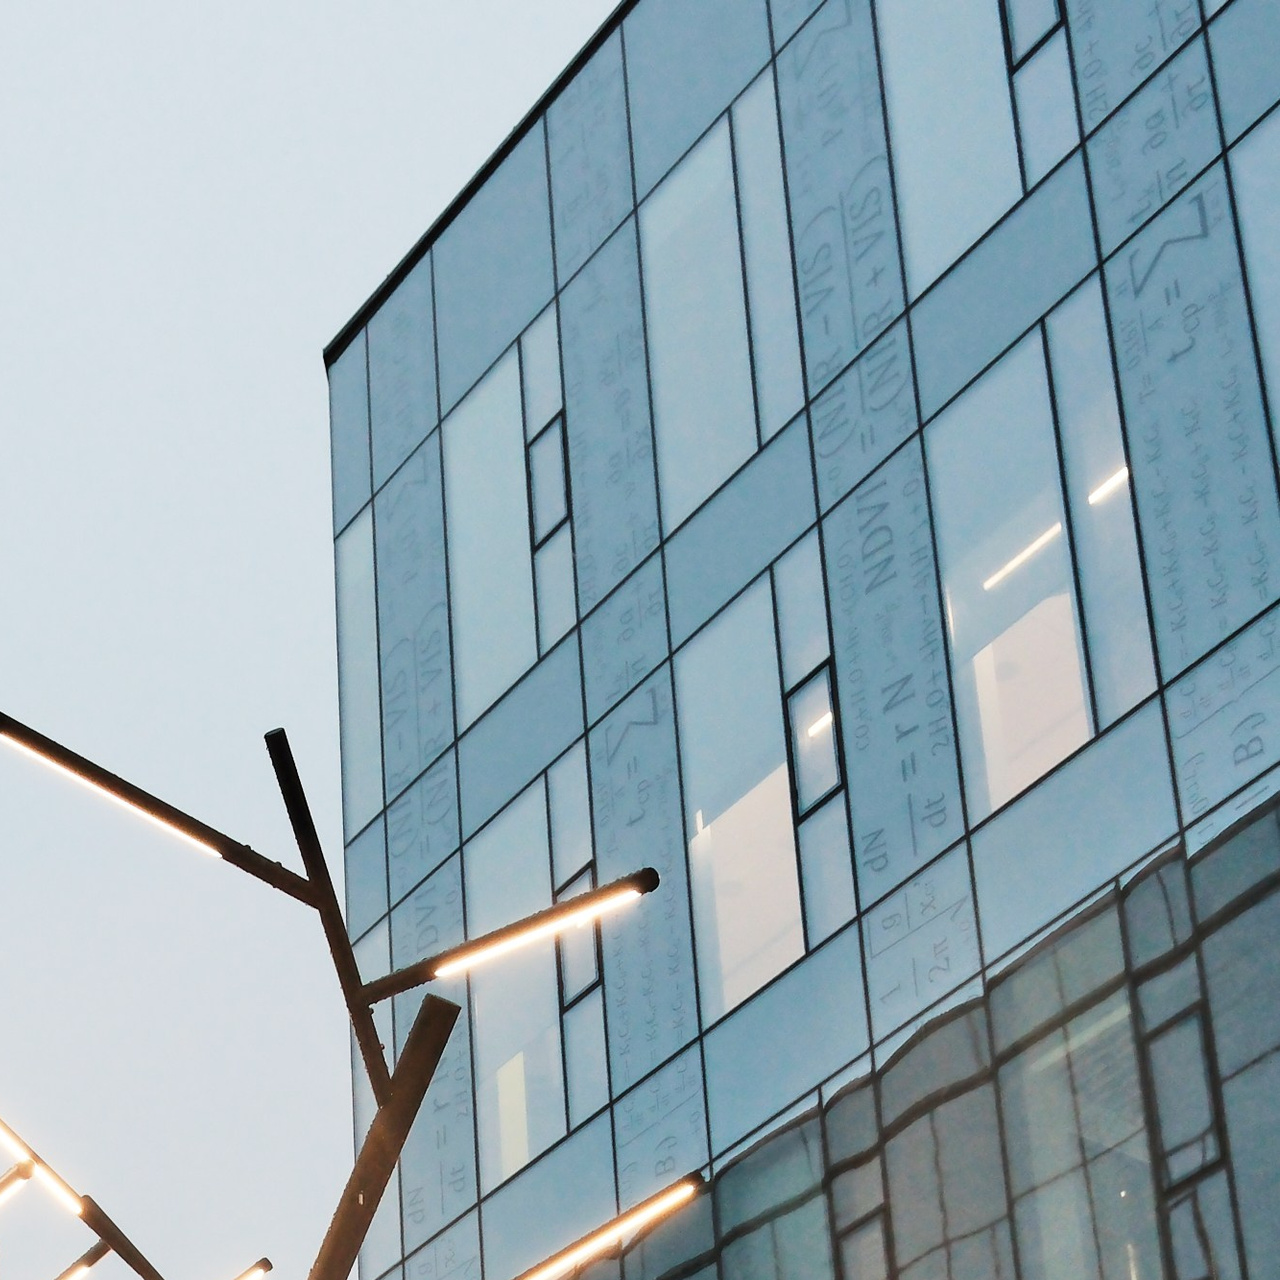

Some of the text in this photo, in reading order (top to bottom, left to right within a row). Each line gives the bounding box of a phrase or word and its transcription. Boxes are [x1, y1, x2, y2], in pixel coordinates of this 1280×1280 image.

[855, 480, 897, 595] NDVI
[920, 792, 948, 829] dt
[414, 883, 439, 955] DVI
